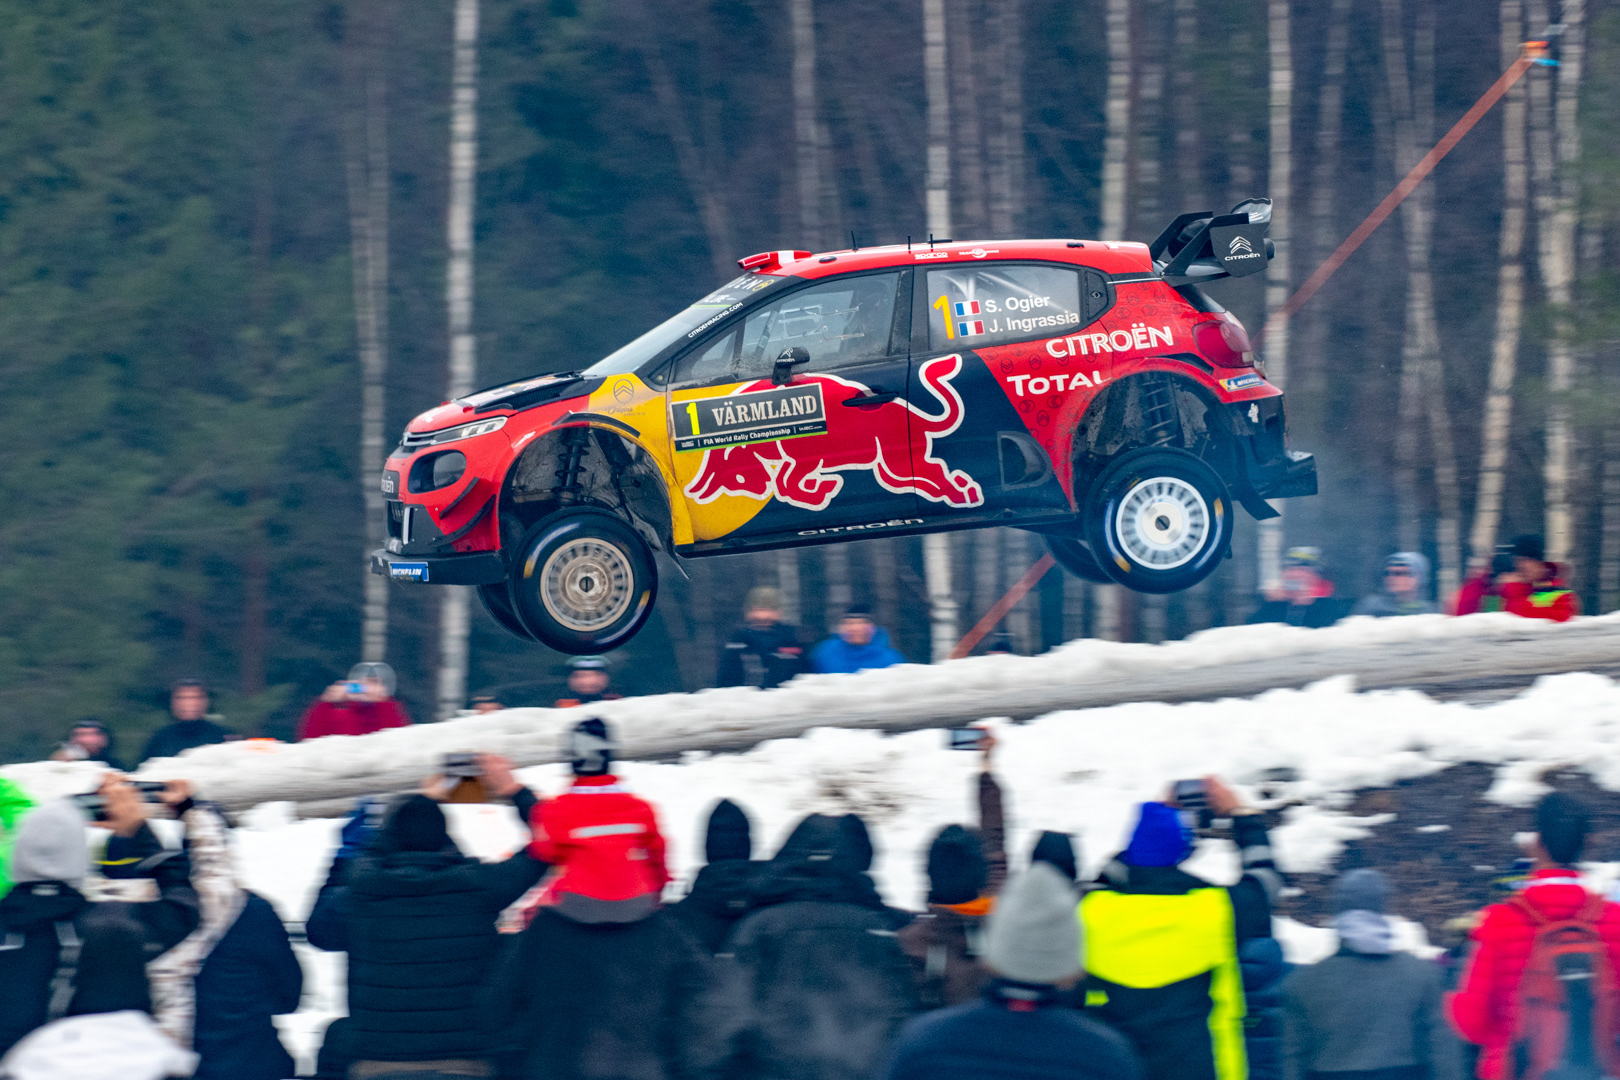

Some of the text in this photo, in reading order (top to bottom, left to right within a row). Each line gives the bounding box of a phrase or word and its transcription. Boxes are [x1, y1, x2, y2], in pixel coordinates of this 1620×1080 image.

[688, 302, 743, 338] CITROENRACING.COM
[933, 295, 955, 340] 1
[985, 295, 1050, 313] S. Ogier
[989, 311, 1080, 333] J. Ingrassia
[1046, 322, 1174, 358] CITROËN
[686, 402, 700, 436] 1
[711, 395, 817, 427] VÄRMLAND
[703, 428, 791, 446] FIA World Rally Championship
